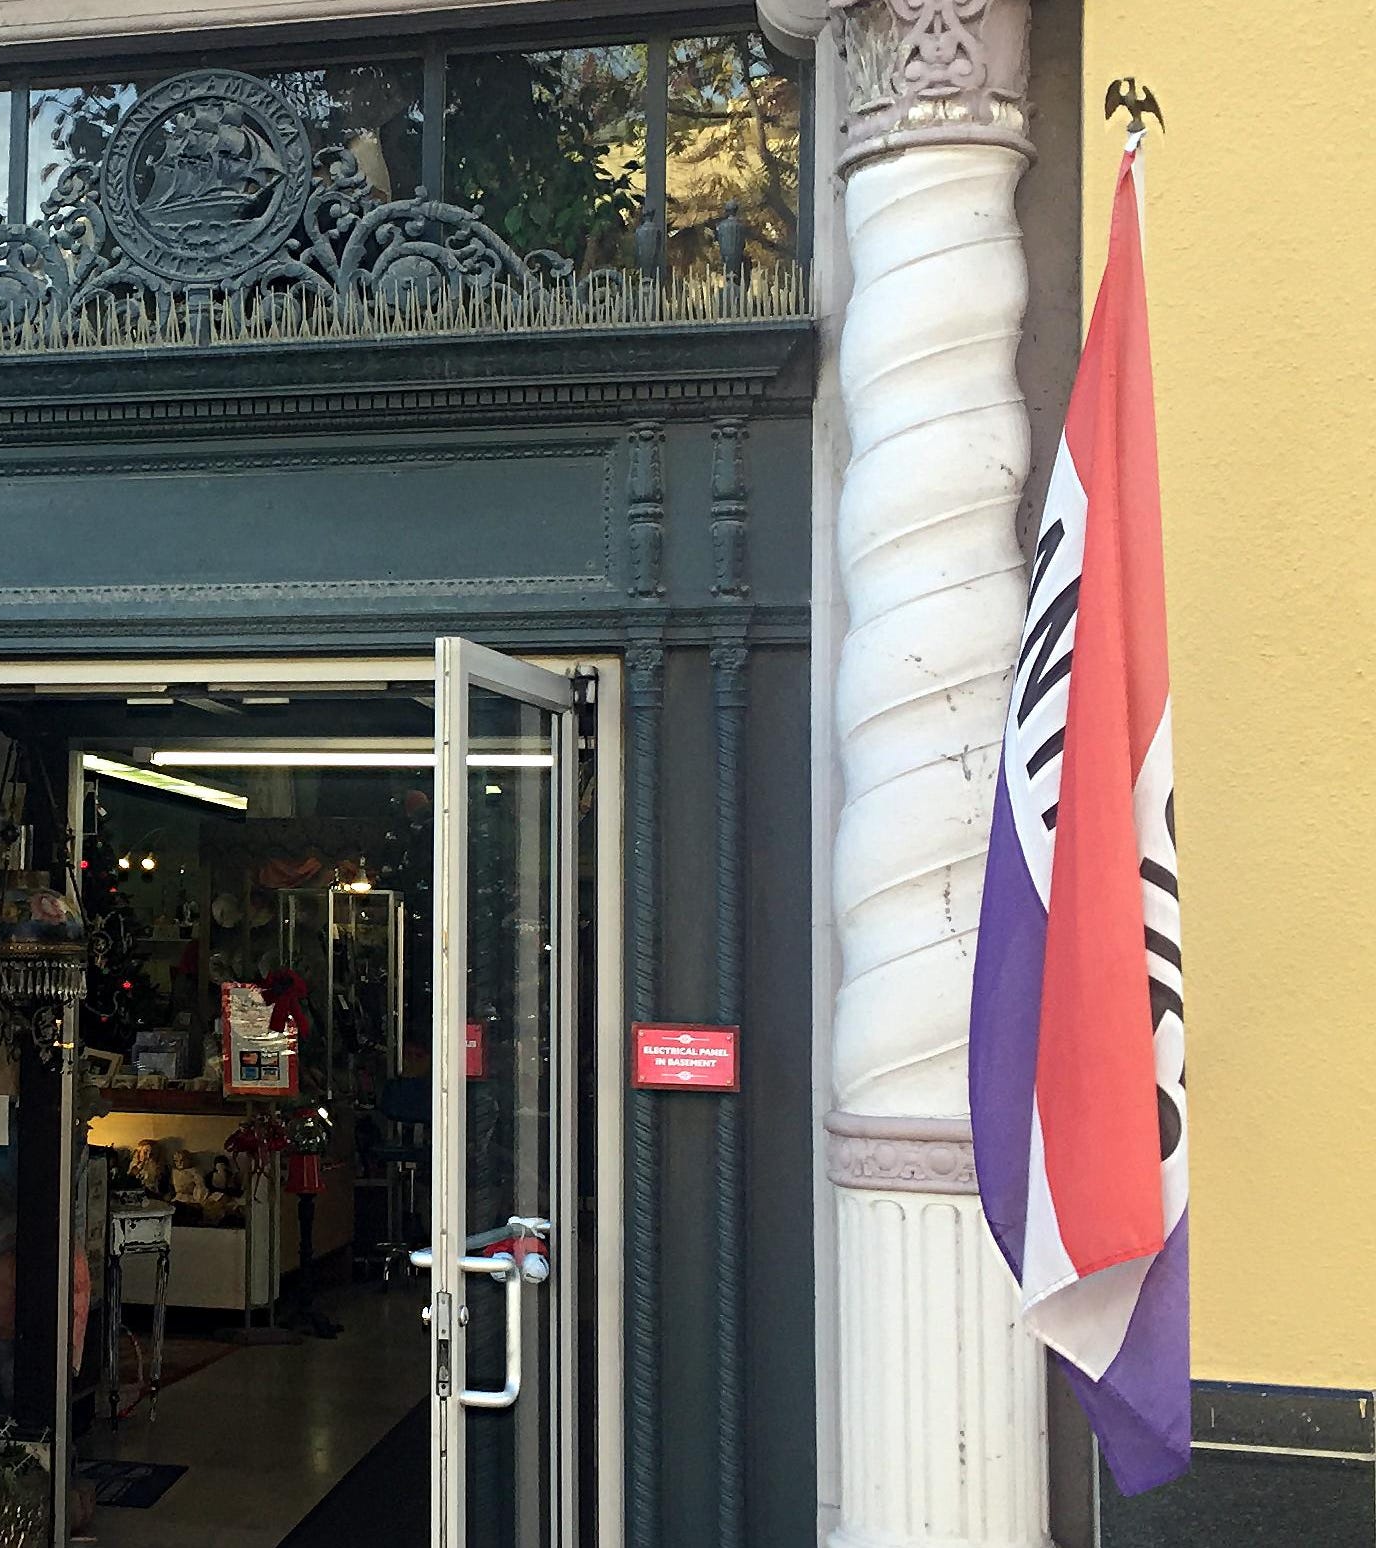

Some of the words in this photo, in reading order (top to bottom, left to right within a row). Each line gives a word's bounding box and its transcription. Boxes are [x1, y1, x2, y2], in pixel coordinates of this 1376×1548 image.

[205, 75, 299, 148] AMERICA
[643, 1046, 698, 1056] ELECTRICAL
[699, 1048, 729, 1057] PANEL
[655, 1057, 666, 1066] IN
[668, 1058, 717, 1067] BASEMENT
